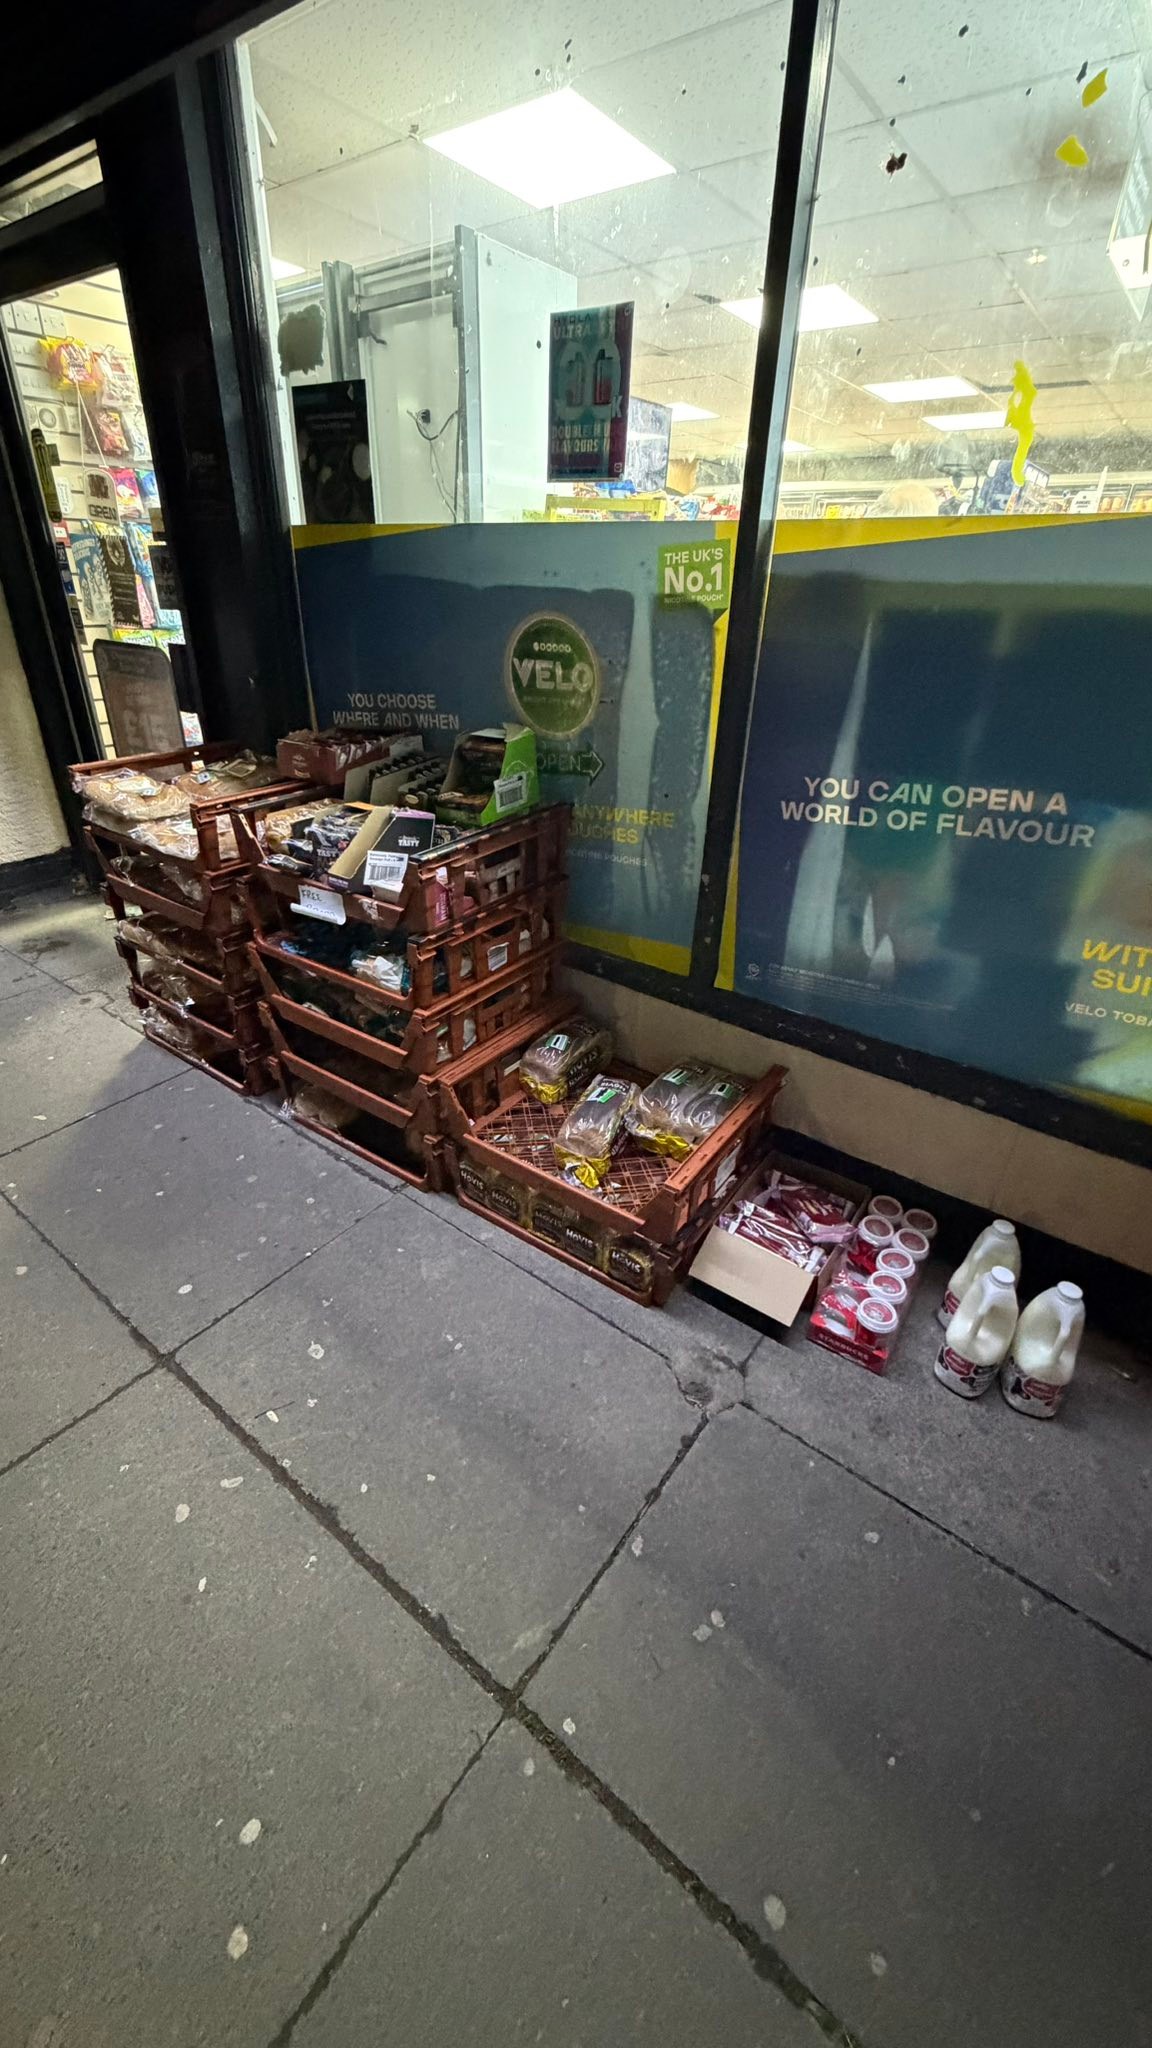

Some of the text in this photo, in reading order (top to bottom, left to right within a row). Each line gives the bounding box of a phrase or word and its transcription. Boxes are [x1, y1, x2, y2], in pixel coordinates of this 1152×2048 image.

[88, 504, 117, 521] OPEN
[664, 547, 724, 566] THE UK'S
[664, 562, 723, 594] No.1
[513, 657, 594, 693] VELO
[347, 692, 438, 710] YOU CHOOSE
[332, 710, 460, 730] WHERE AND WHEN
[536, 752, 581, 772] OPEN
[804, 776, 1068, 816] YOU CAN OPEN A
[780, 800, 1097, 849] WORLD OF FLAVOUR
[397, 839, 420, 848] TASTY
[301, 888, 322, 903] FREE
[1064, 1001, 1107, 1018] VELO
[460, 1169, 484, 1190] HOVIS
[491, 1190, 517, 1210] HOVIS
[566, 1228, 594, 1248] HOVIS
[611, 1251, 641, 1274] HOVIS
